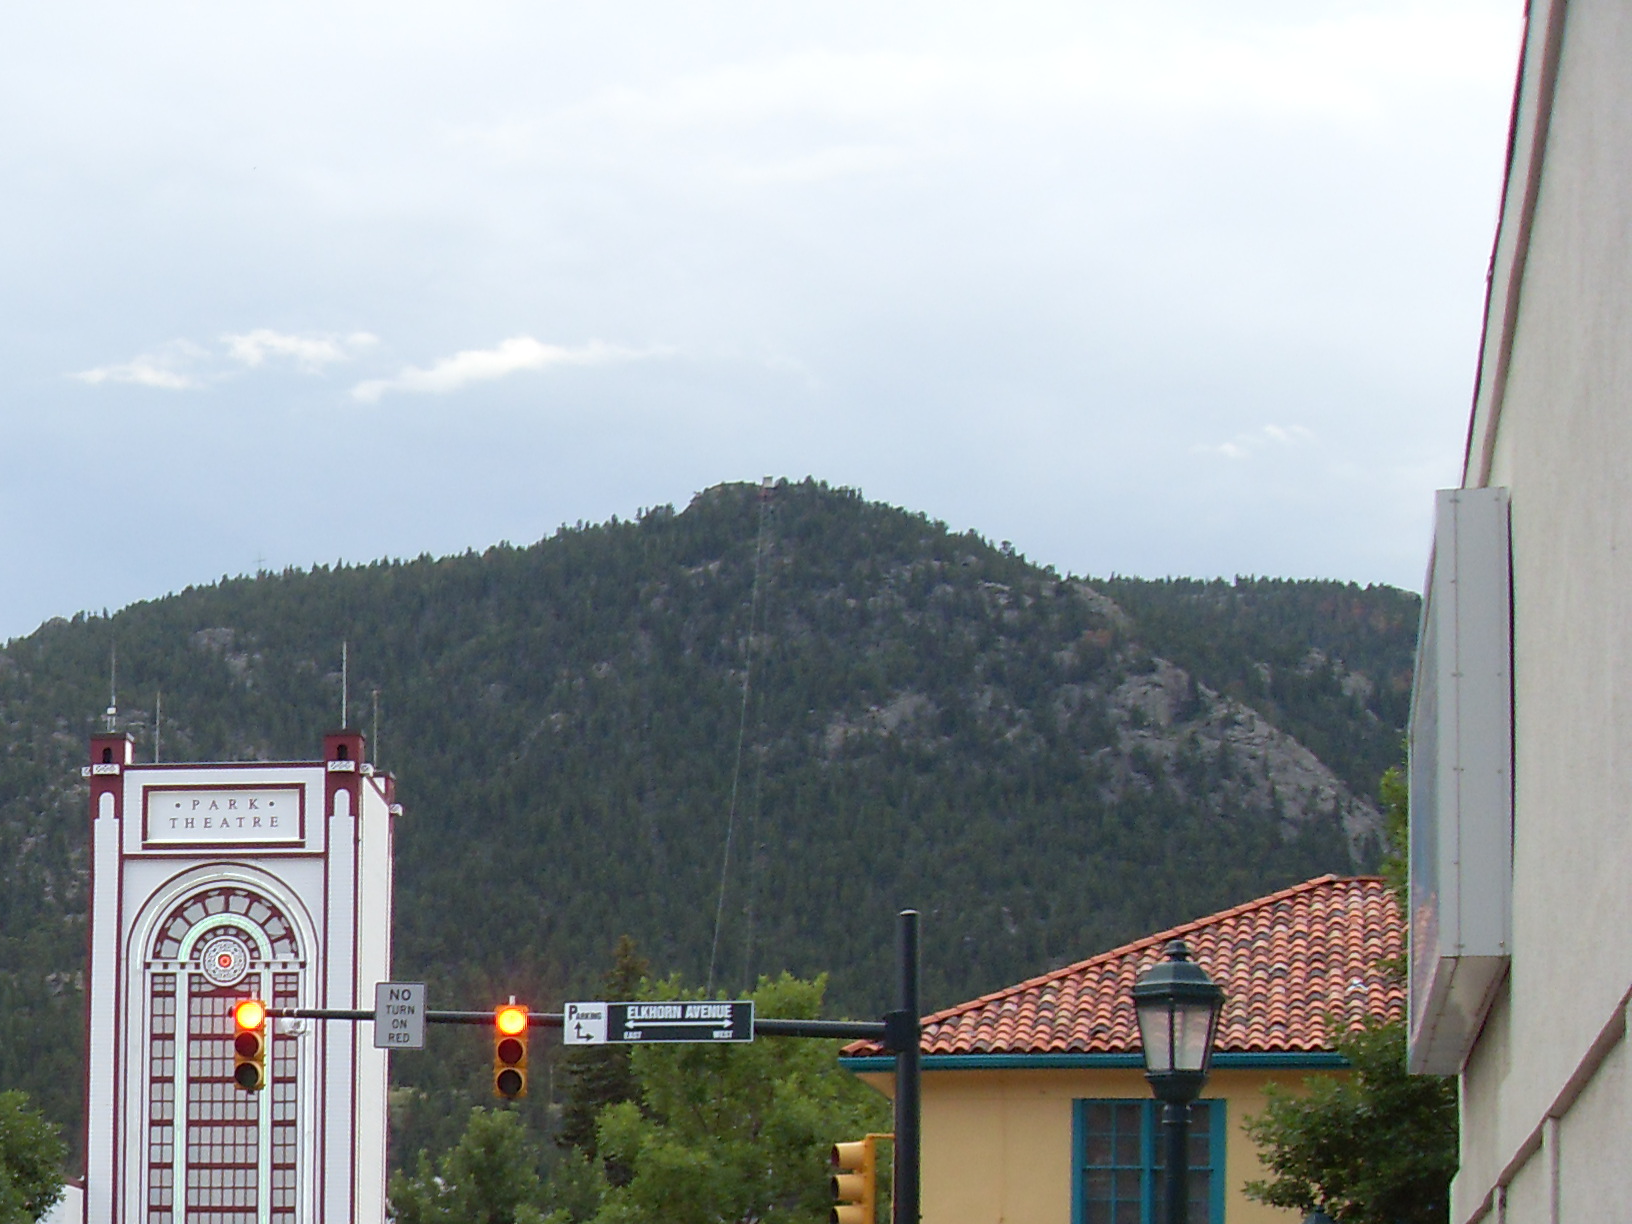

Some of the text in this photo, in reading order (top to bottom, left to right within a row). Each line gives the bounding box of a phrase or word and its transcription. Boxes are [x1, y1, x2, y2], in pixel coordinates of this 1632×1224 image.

[191, 798, 260, 811] PARK
[169, 816, 280, 829] THEATRE
[389, 988, 412, 1001] NO
[386, 1004, 415, 1015] TURN
[626, 1004, 733, 1019] ELKHORN AVENUE
[391, 1018, 408, 1029] ON
[388, 1032, 410, 1043] RED
